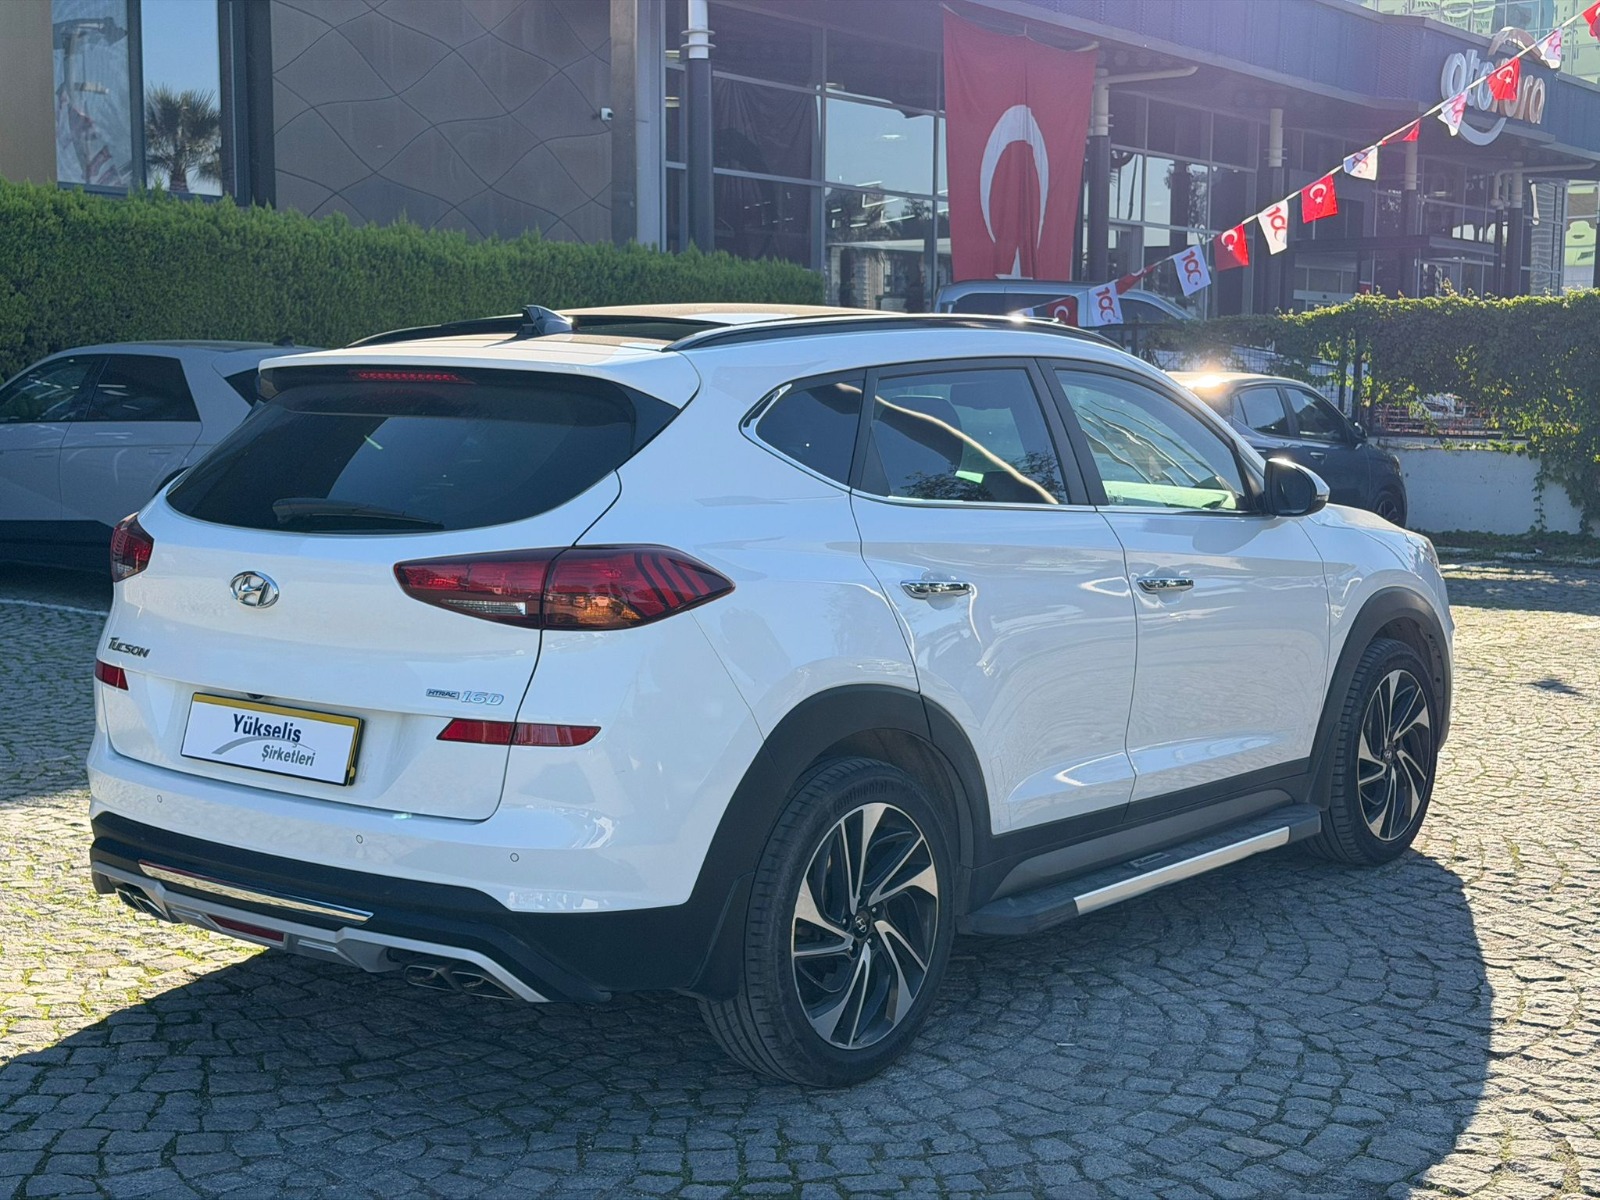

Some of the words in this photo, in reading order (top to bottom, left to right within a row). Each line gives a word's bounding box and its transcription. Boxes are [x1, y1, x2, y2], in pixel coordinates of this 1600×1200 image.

[460, 691, 504, 705] 16D
[233, 713, 302, 747] Yükseliş
[261, 744, 316, 767] Şirketleri
